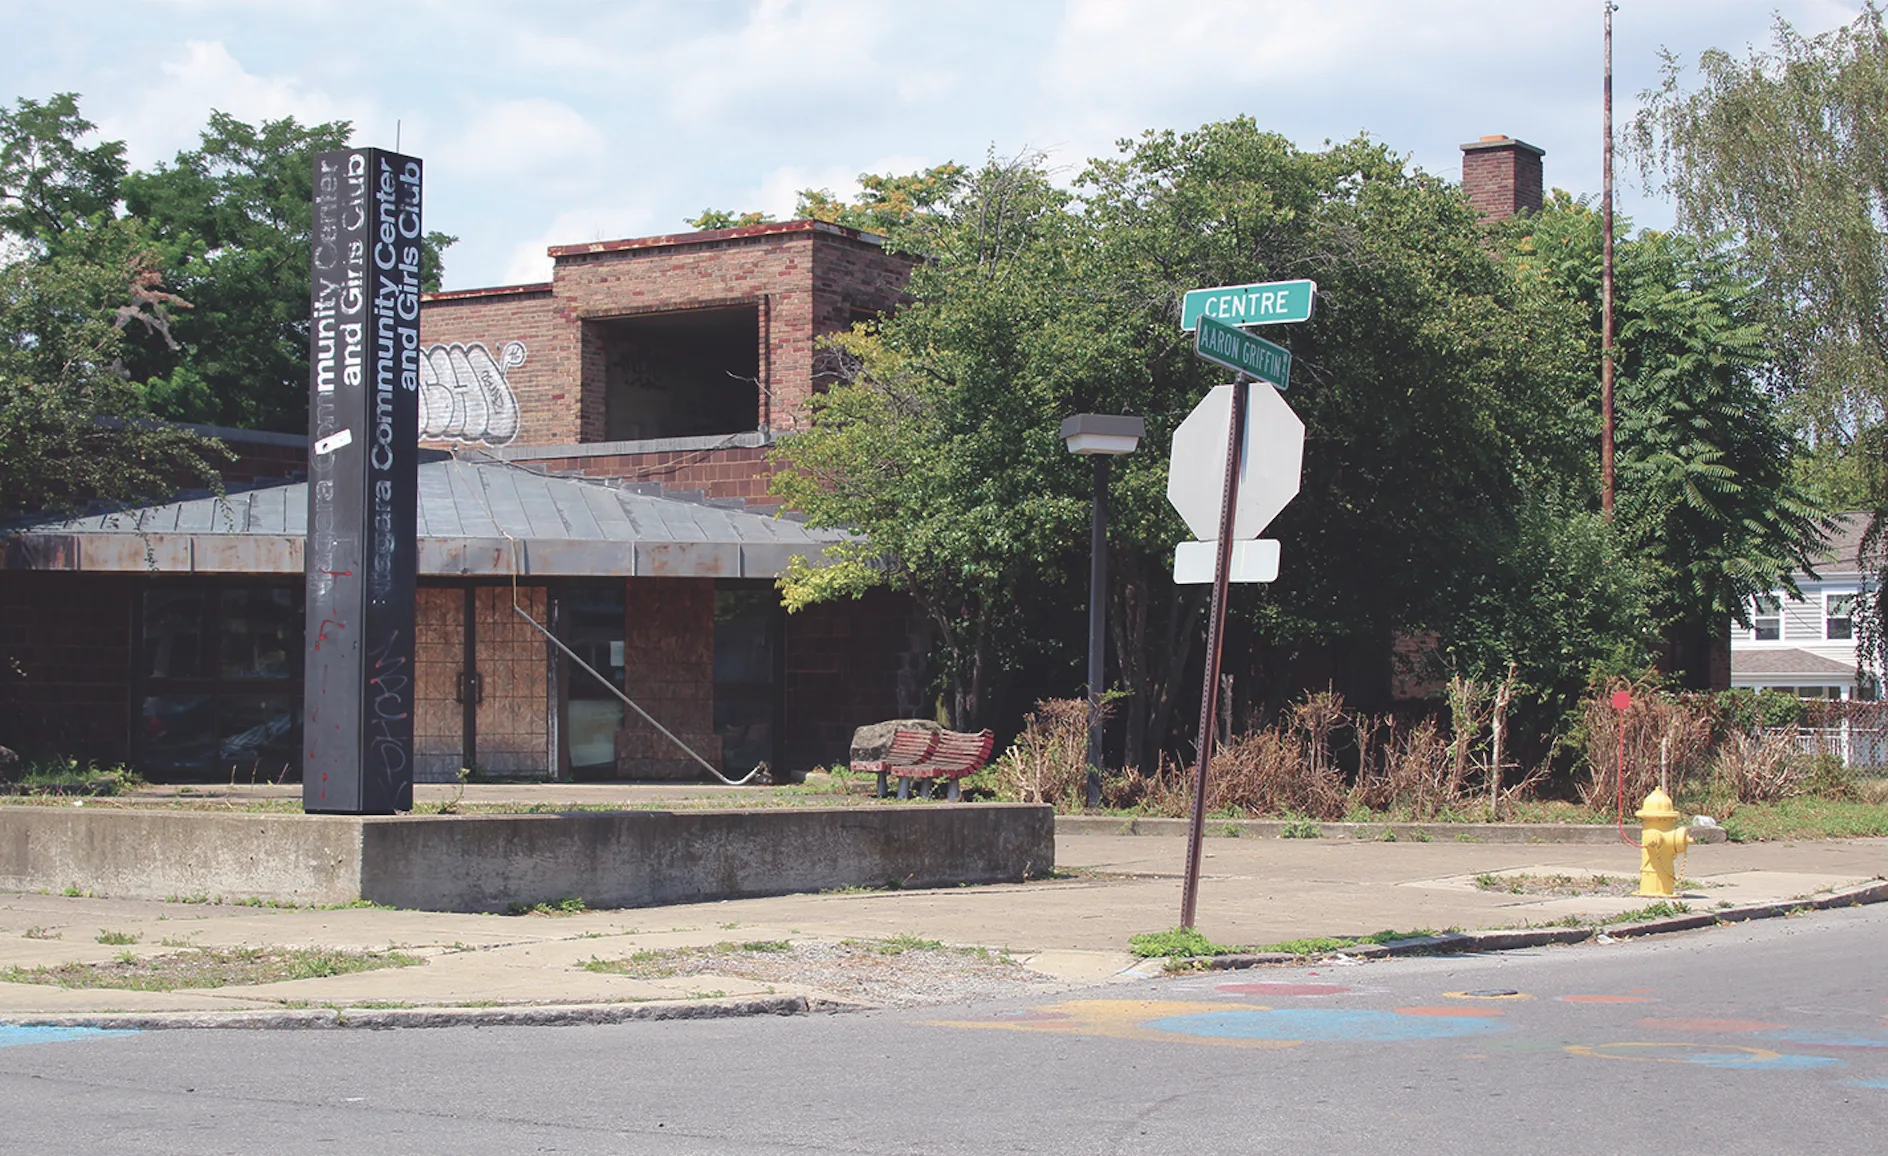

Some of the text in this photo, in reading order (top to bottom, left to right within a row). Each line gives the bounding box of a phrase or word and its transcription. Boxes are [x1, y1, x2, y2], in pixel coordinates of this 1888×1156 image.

[315, 160, 338, 270] Center
[340, 153, 366, 387] and Girls Club
[374, 157, 397, 270] Center
[397, 162, 421, 392] and Girls Club
[1204, 290, 1289, 319] CENTRE
[371, 275, 400, 471] Community
[1200, 324, 1282, 378] AARON GRIFFIN
